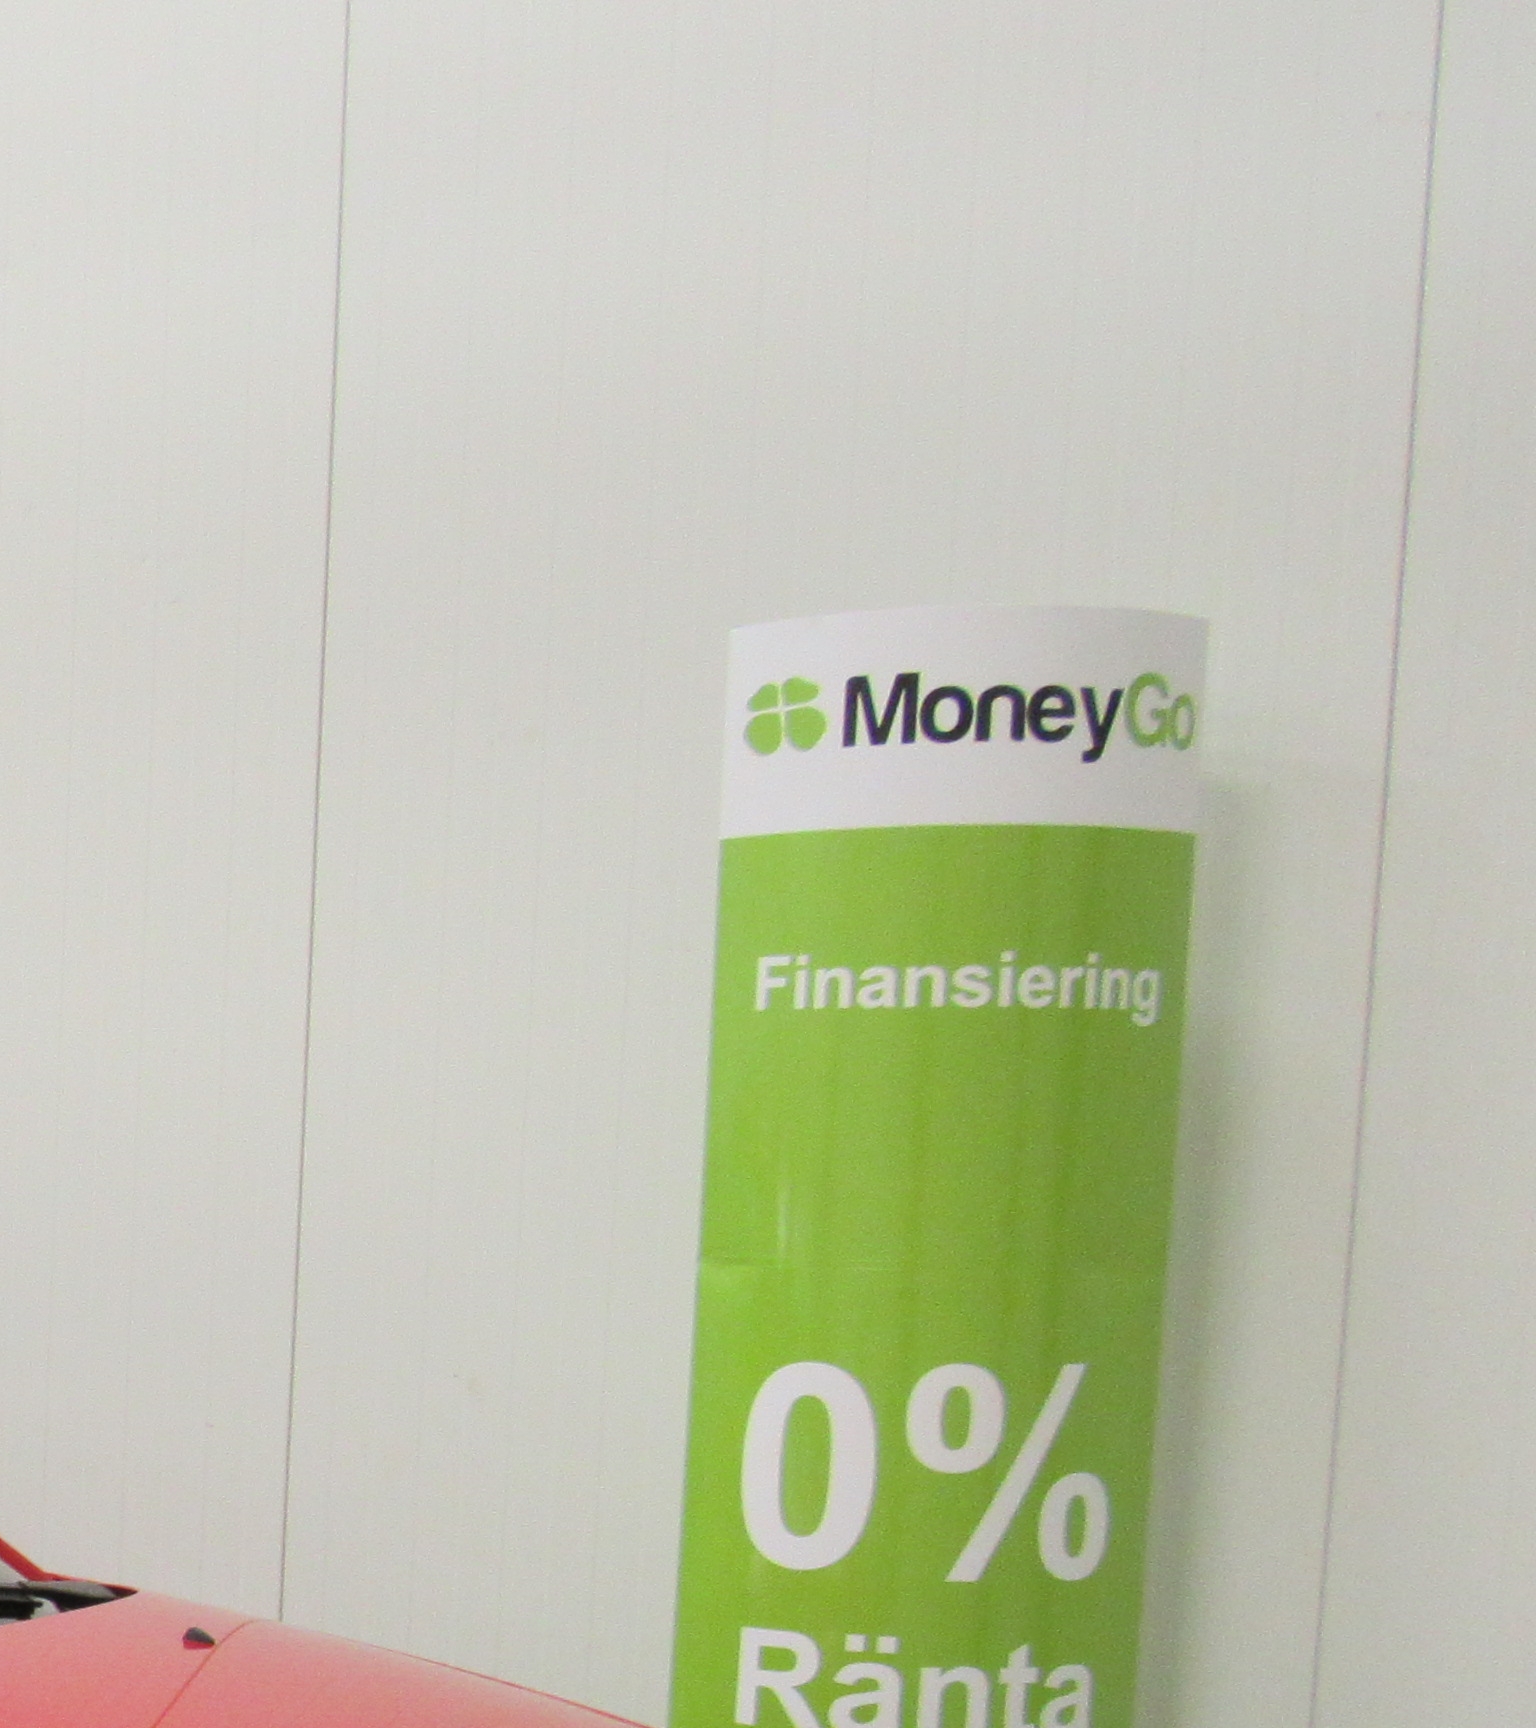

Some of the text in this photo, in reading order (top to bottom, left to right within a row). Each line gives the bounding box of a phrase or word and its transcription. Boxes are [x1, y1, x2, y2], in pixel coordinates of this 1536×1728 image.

[842, 671, 1196, 763] MoneyGo
[754, 950, 1164, 1026] Finansiering
[741, 1361, 1112, 1583] 0%
